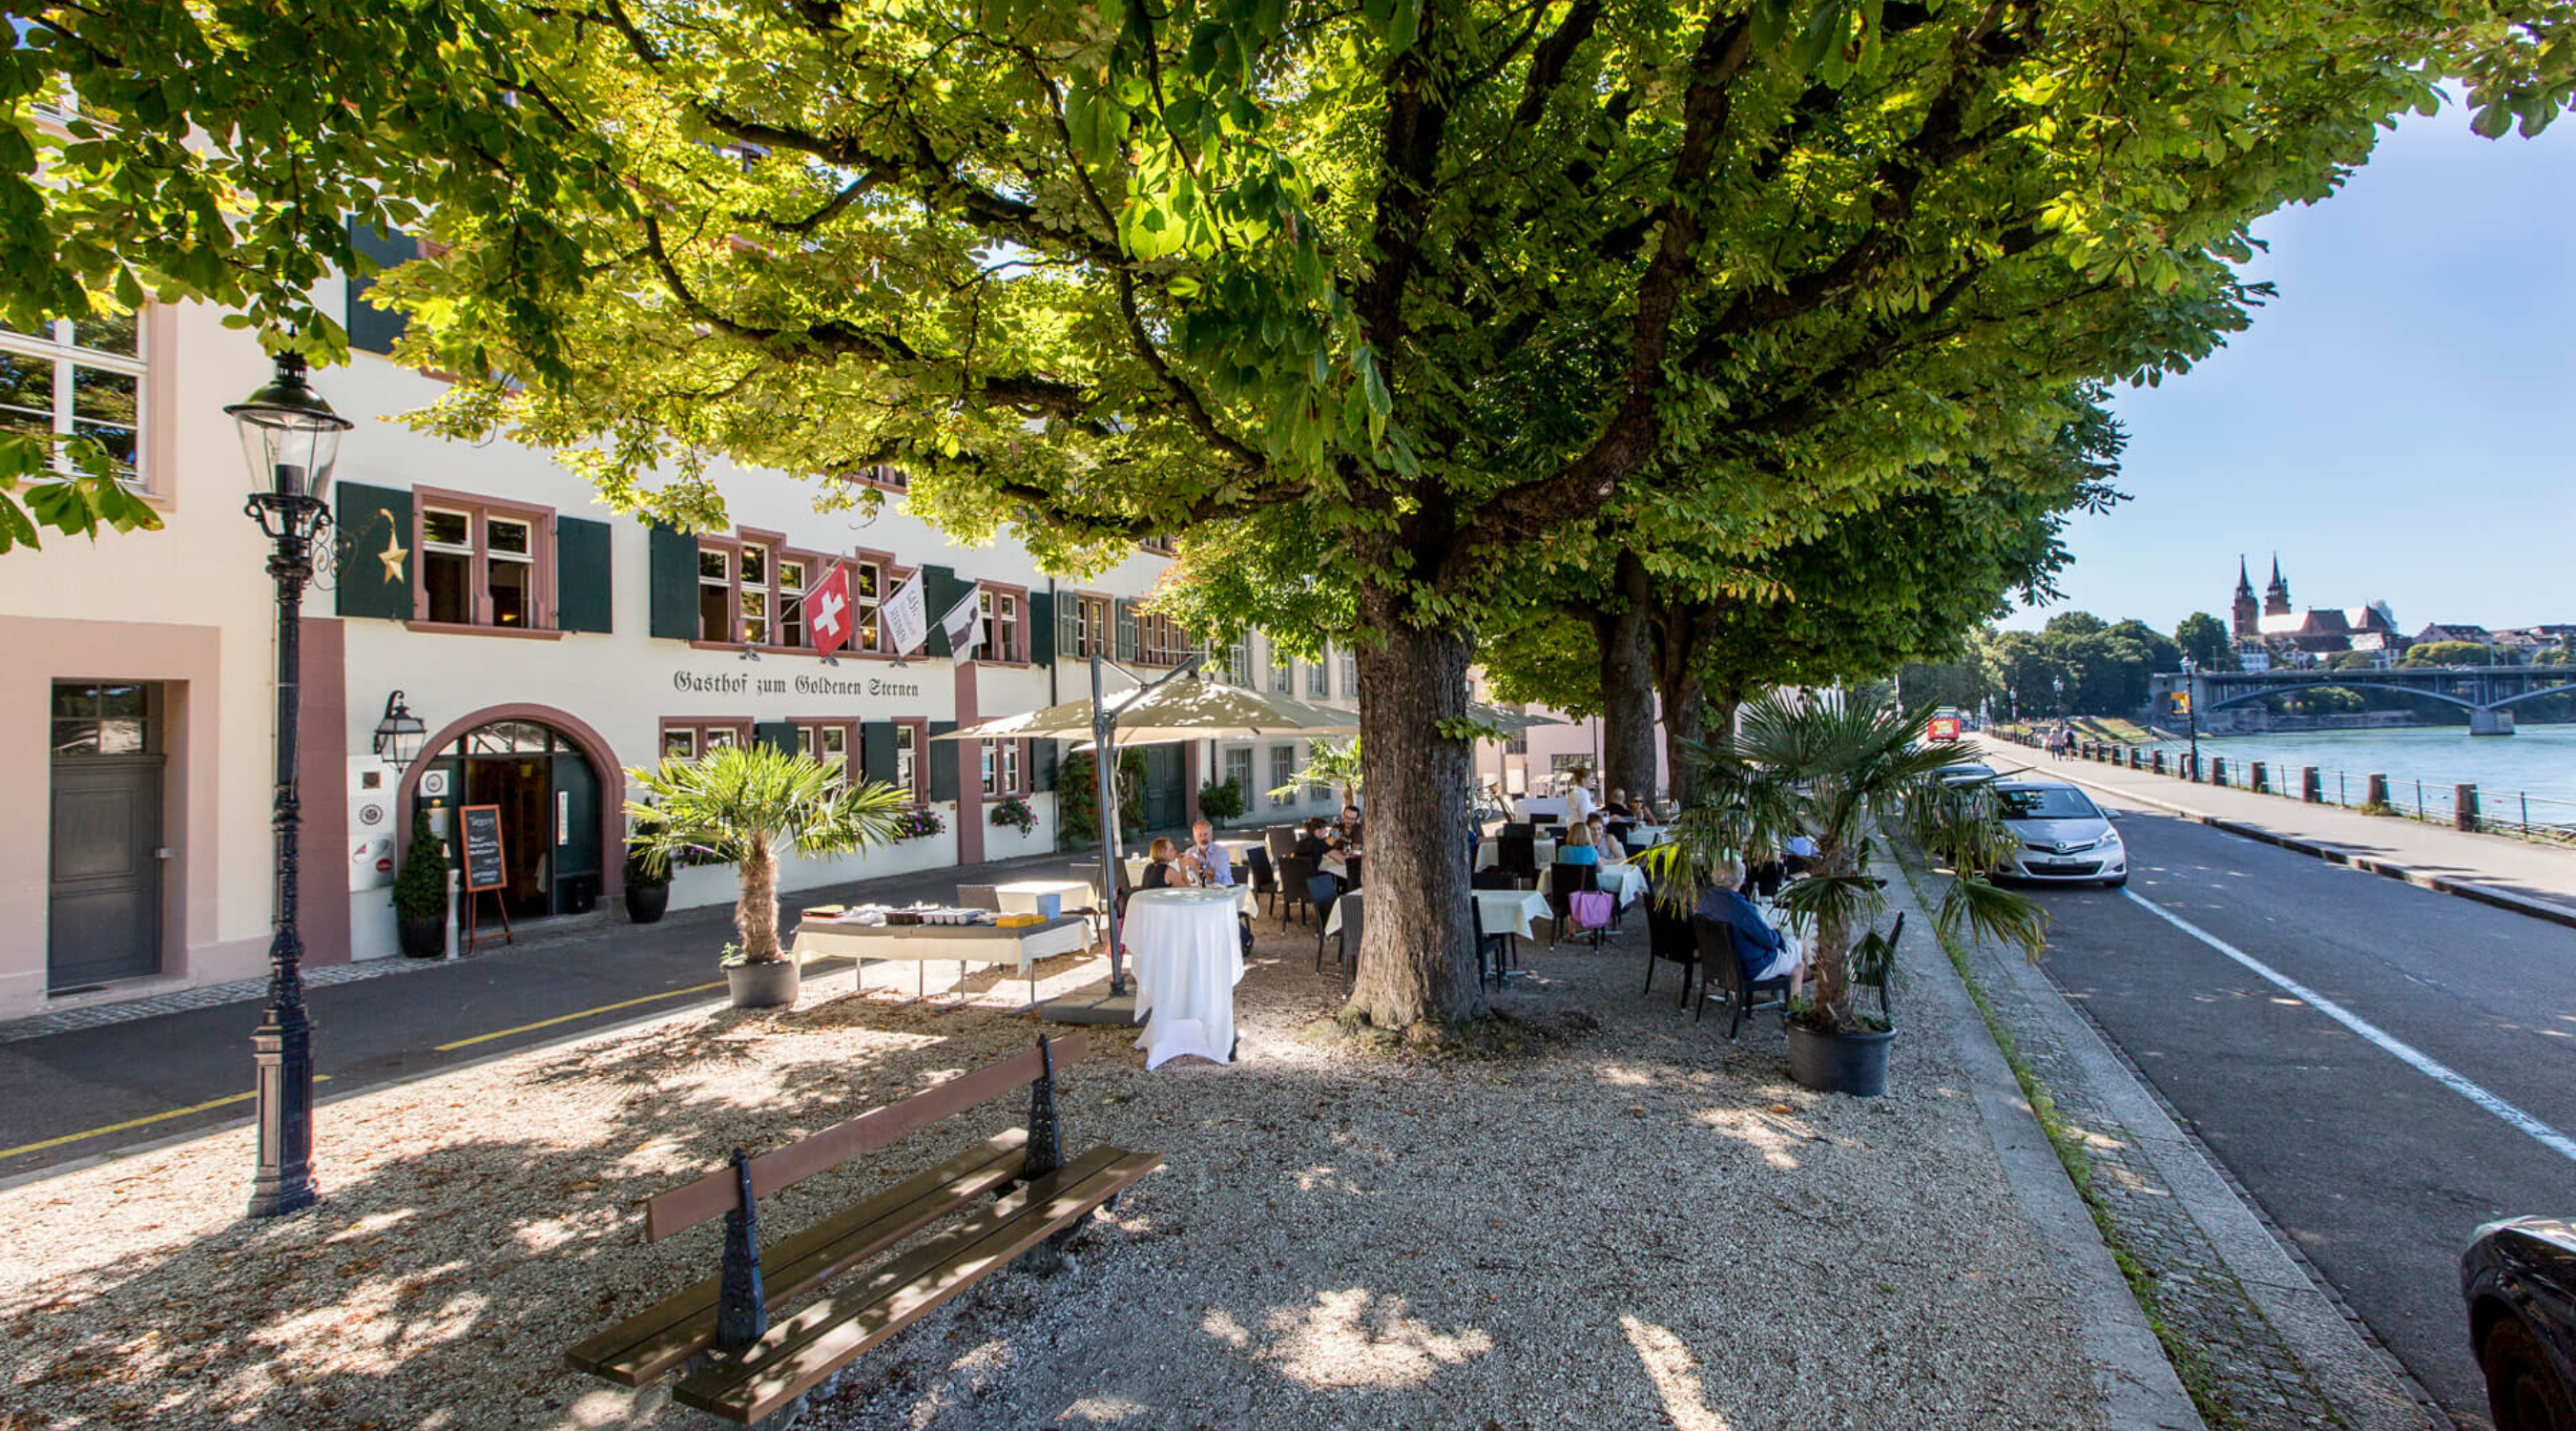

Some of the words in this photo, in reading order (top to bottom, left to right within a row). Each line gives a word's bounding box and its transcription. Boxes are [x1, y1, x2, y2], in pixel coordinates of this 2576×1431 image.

[674, 670, 748, 694] Gasthof
[757, 678, 786, 696] zum
[795, 674, 862, 695] Goldenen
[868, 678, 919, 697] Sternen
